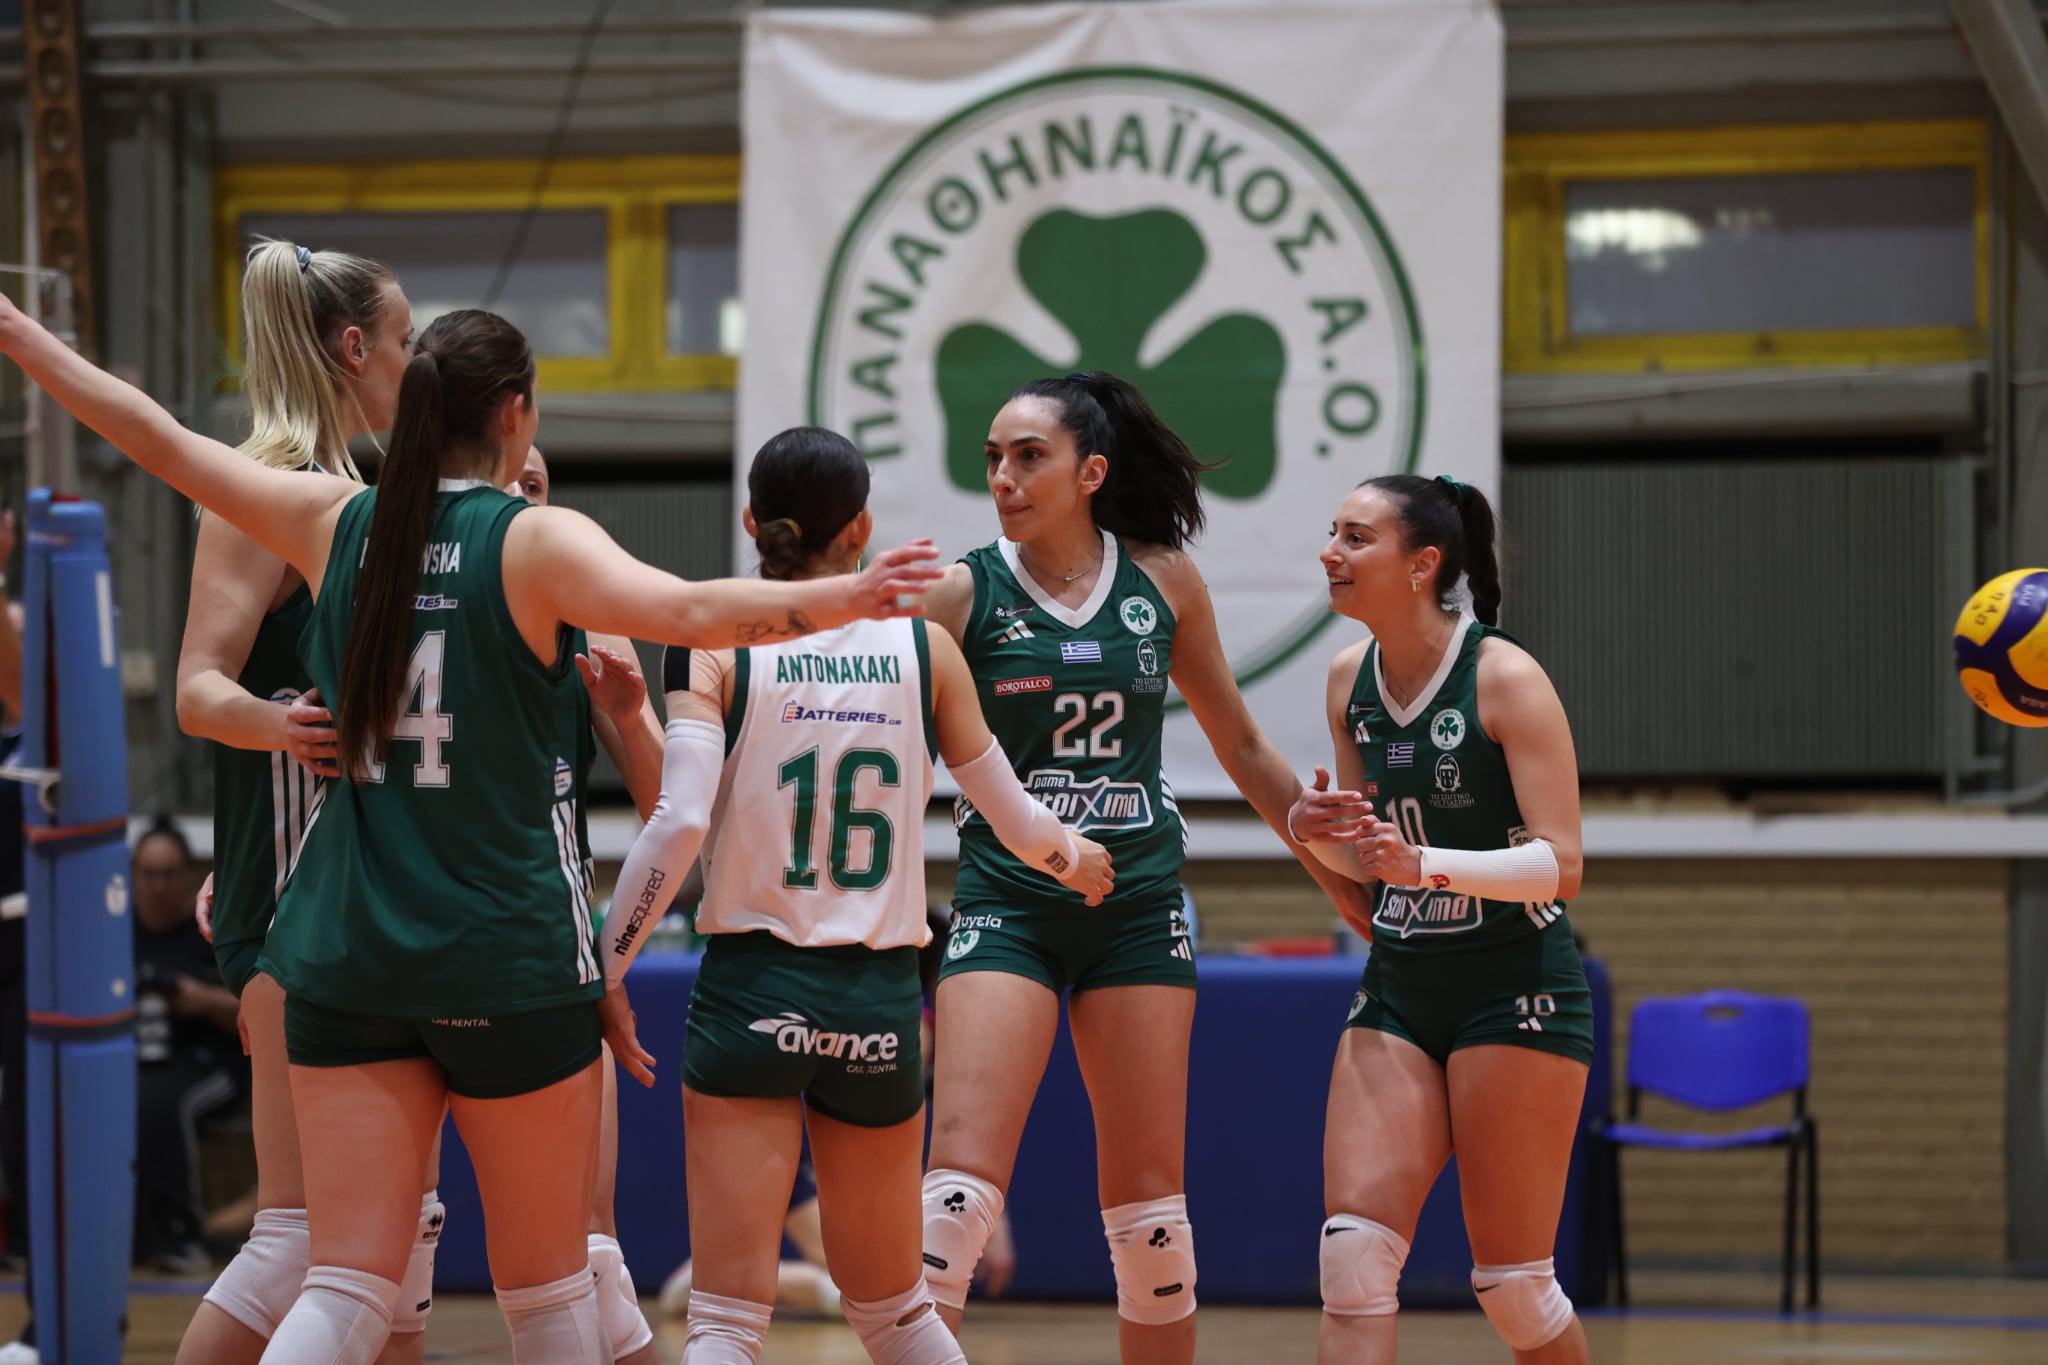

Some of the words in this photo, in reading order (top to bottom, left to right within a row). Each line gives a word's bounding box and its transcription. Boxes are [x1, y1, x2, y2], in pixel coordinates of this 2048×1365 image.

[850, 105, 1340, 461] ΠΑΝΑΘΗΝΑΪΚΟΣ
[777, 654, 900, 684] ANTONAKAKI
[996, 679, 1050, 693] BOROTALCO
[1052, 691, 1125, 758] 22
[1034, 775, 1066, 789] pame
[777, 744, 901, 892] 16
[614, 867, 665, 956] ninesquared
[1515, 994, 1556, 1016] 10
[451, 1018, 491, 1028] RENTAL
[777, 1024, 899, 1062] avance
